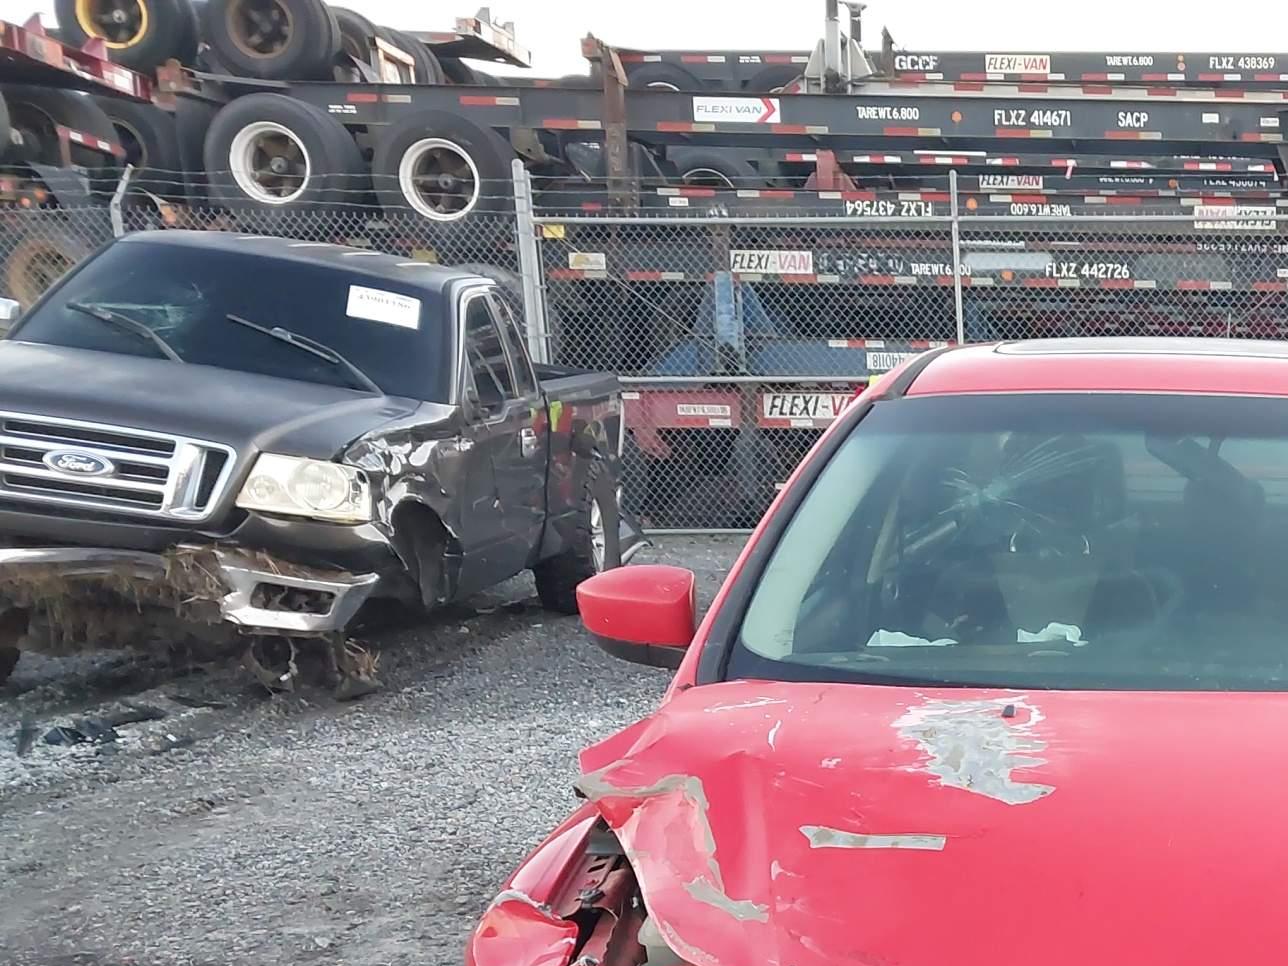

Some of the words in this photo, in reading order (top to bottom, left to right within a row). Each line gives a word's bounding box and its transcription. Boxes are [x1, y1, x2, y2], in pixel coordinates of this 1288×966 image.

[987, 57, 1049, 71] FLEXI-VAN
[1209, 56, 1235, 69] FLXZ
[1238, 56, 1275, 69] 438369
[994, 109, 1025, 126] FLXZ
[1029, 110, 1071, 127] 414671
[1117, 112, 1149, 128] SACP
[980, 175, 1041, 188] FLEXI-VAN
[846, 200, 896, 216] 437564
[901, 201, 932, 217] FLXZ
[732, 253, 810, 271] FLEXI-VAN
[1045, 263, 1076, 278] FLXZ
[1081, 264, 1130, 280] 442726
[58, 454, 95, 471] Ford
